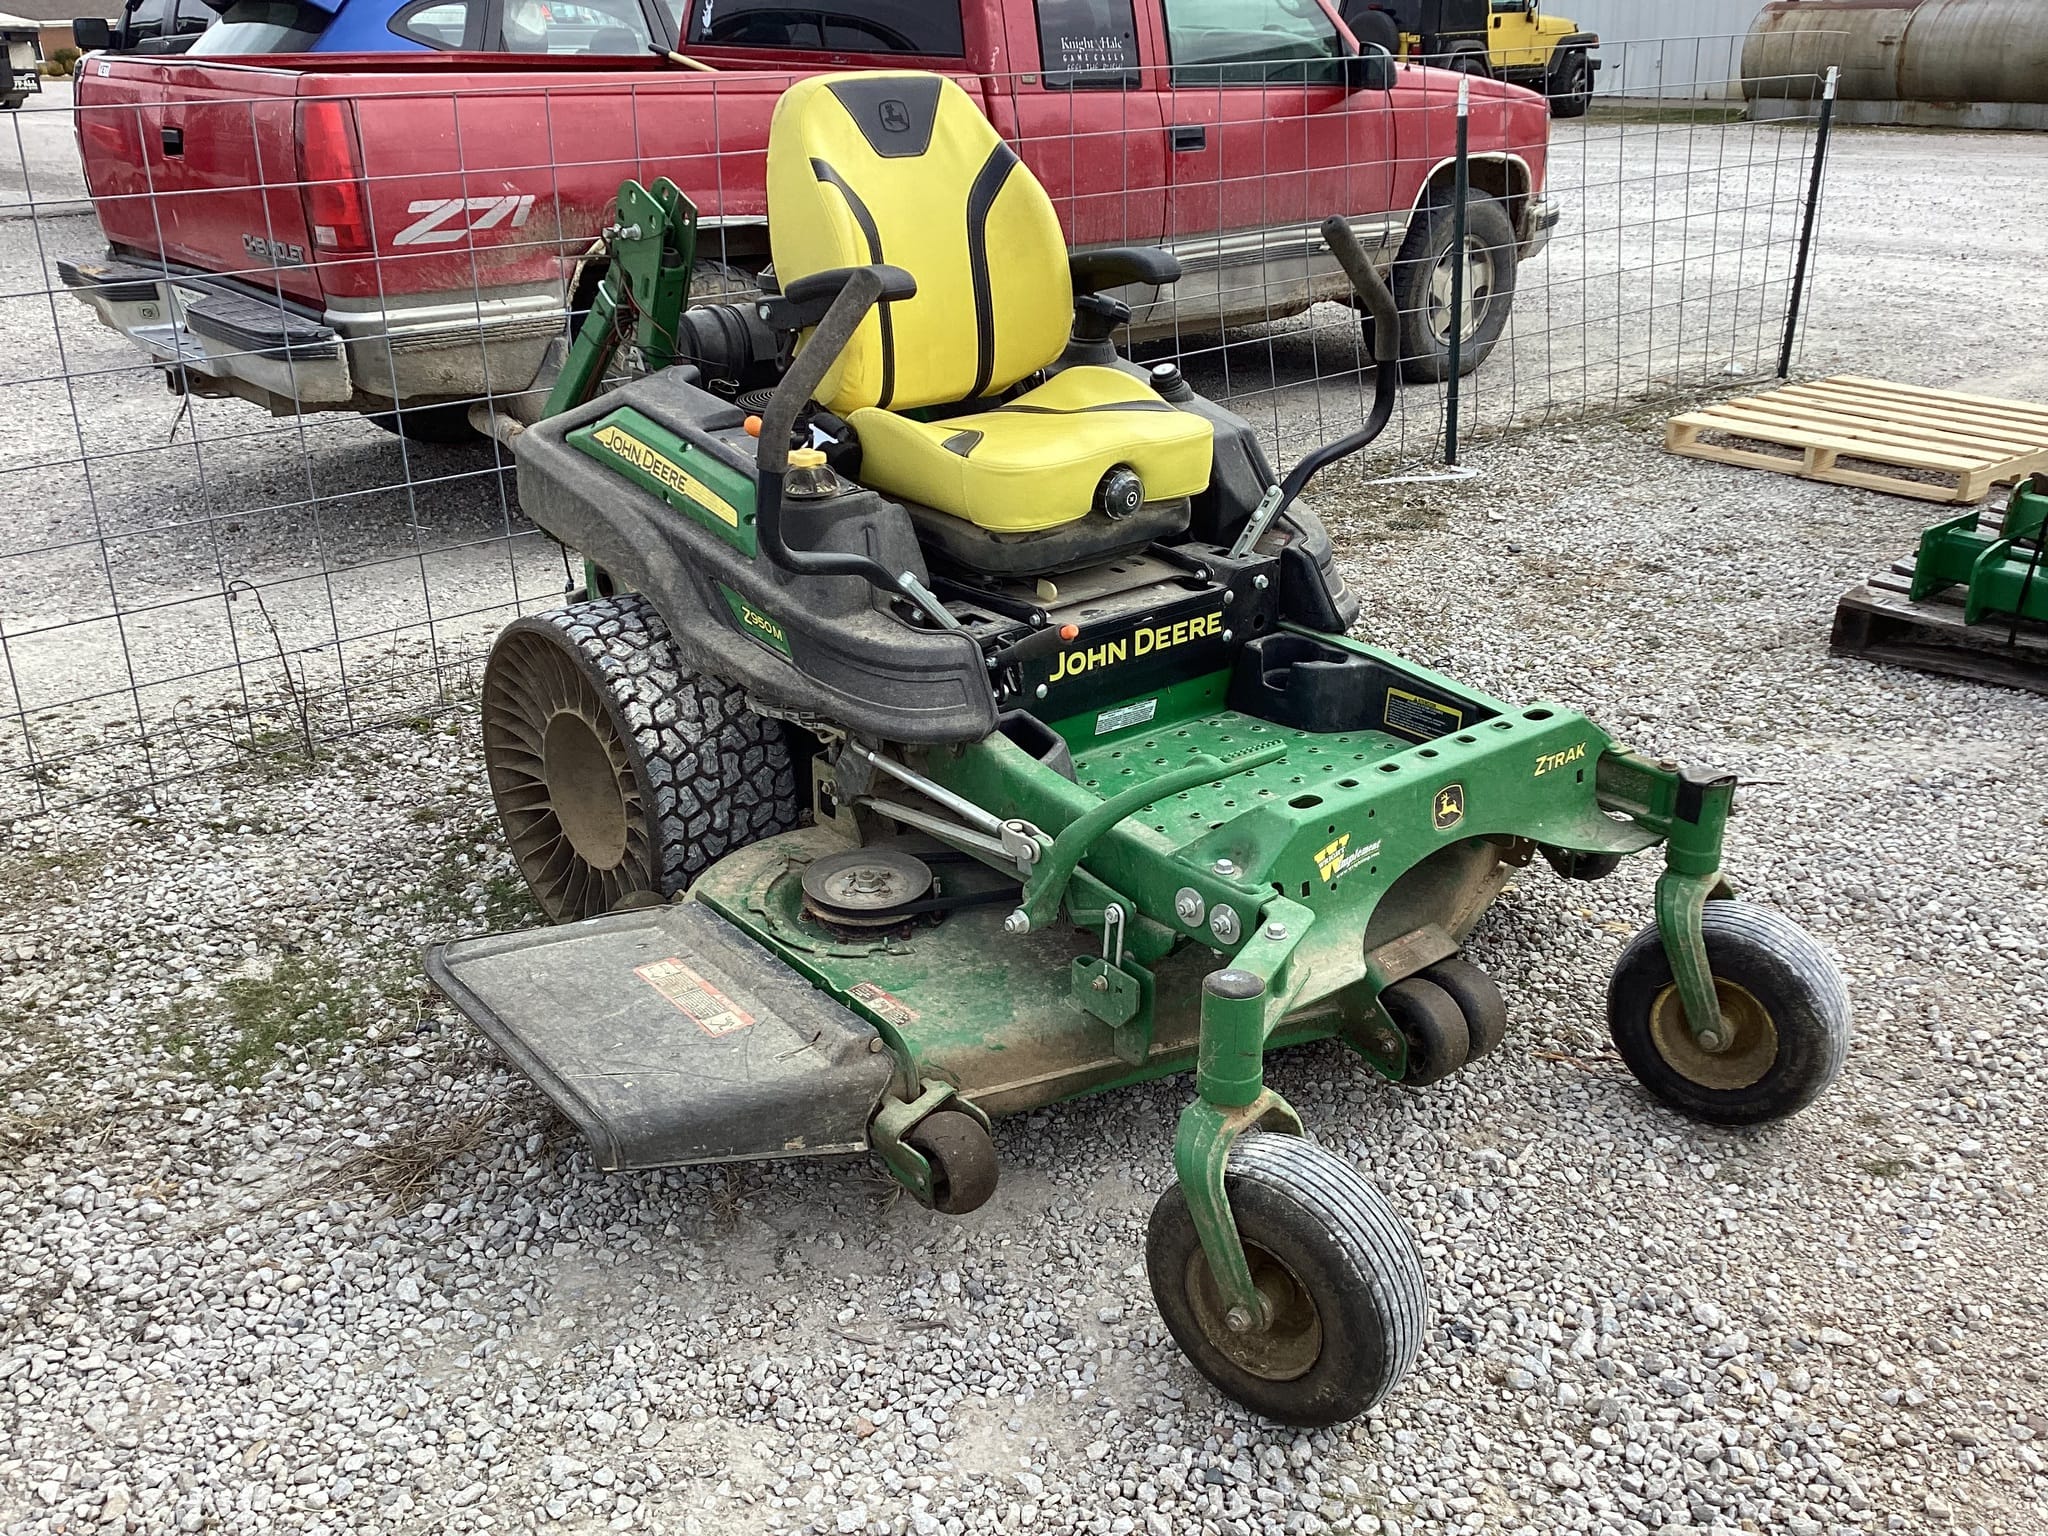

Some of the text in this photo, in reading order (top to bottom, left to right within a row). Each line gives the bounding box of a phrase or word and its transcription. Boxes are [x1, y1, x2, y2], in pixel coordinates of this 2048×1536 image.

[1061, 36, 1095, 53] Knight
[393, 195, 535, 246] Z71
[606, 430, 687, 492] JOHN DEERE
[742, 606, 783, 641] Z950M
[1049, 611, 1223, 682] JOHN DEERE
